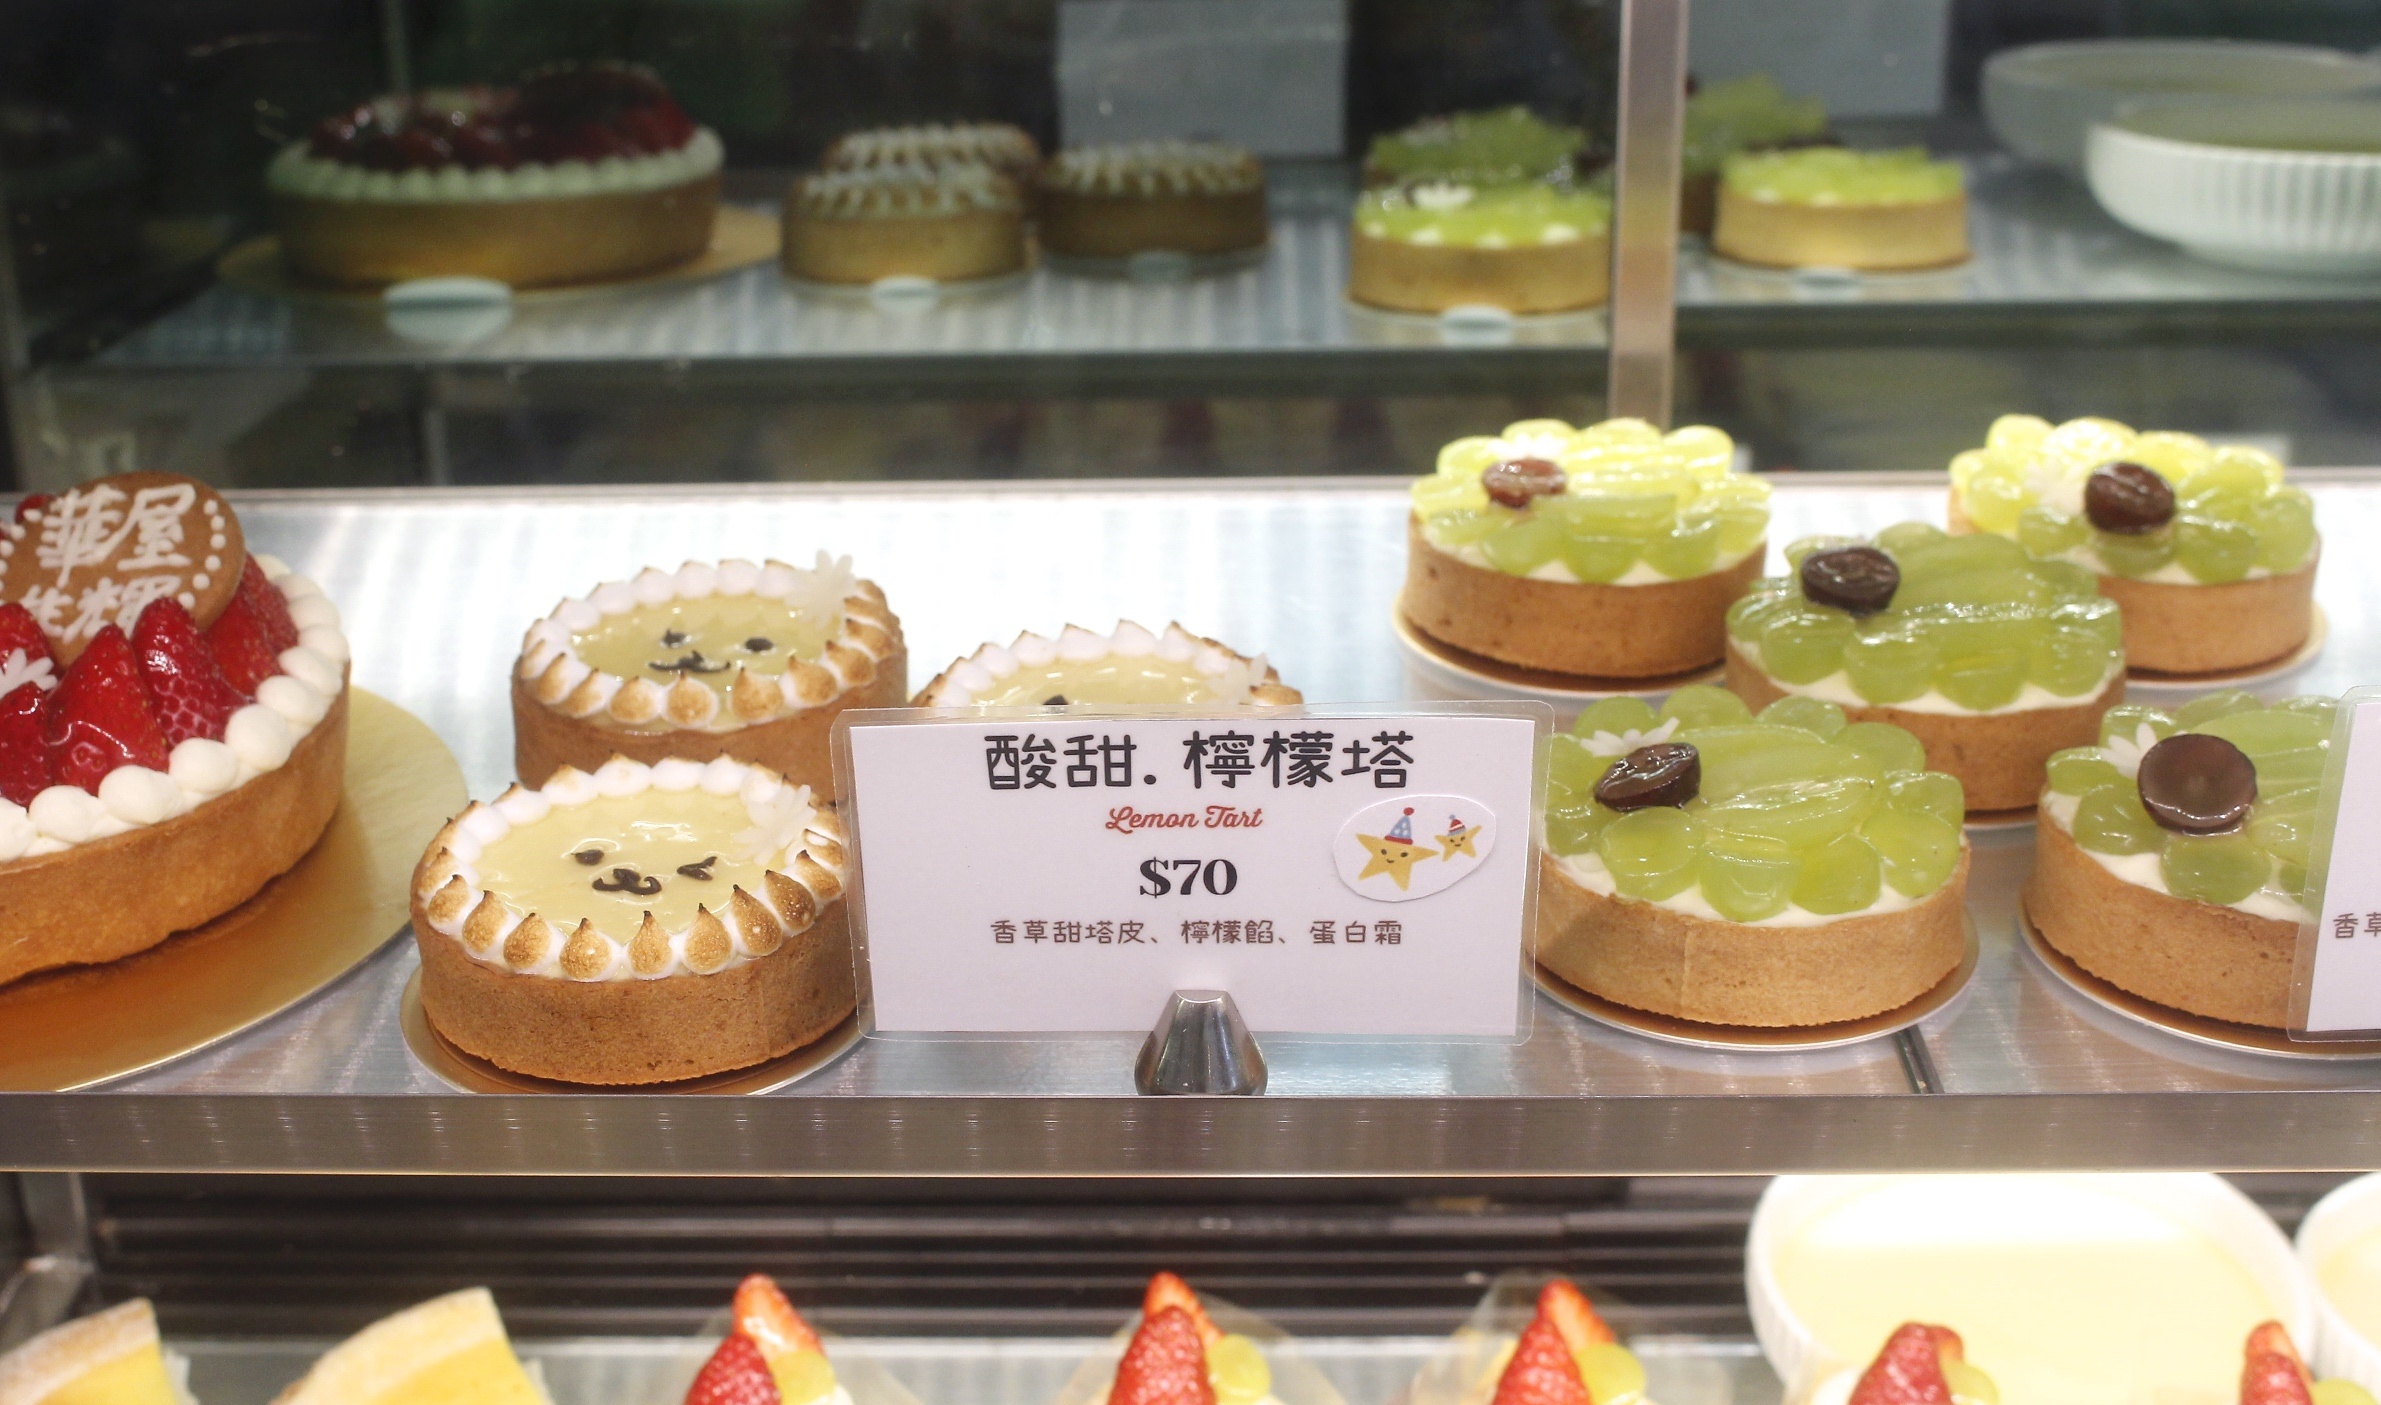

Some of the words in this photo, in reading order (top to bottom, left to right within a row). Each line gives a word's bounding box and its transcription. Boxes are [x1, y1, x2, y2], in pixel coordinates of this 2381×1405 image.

[1105, 806, 1200, 835] Lemon
[1203, 805, 1264, 829] Tart
[1139, 857, 1238, 898] $70
